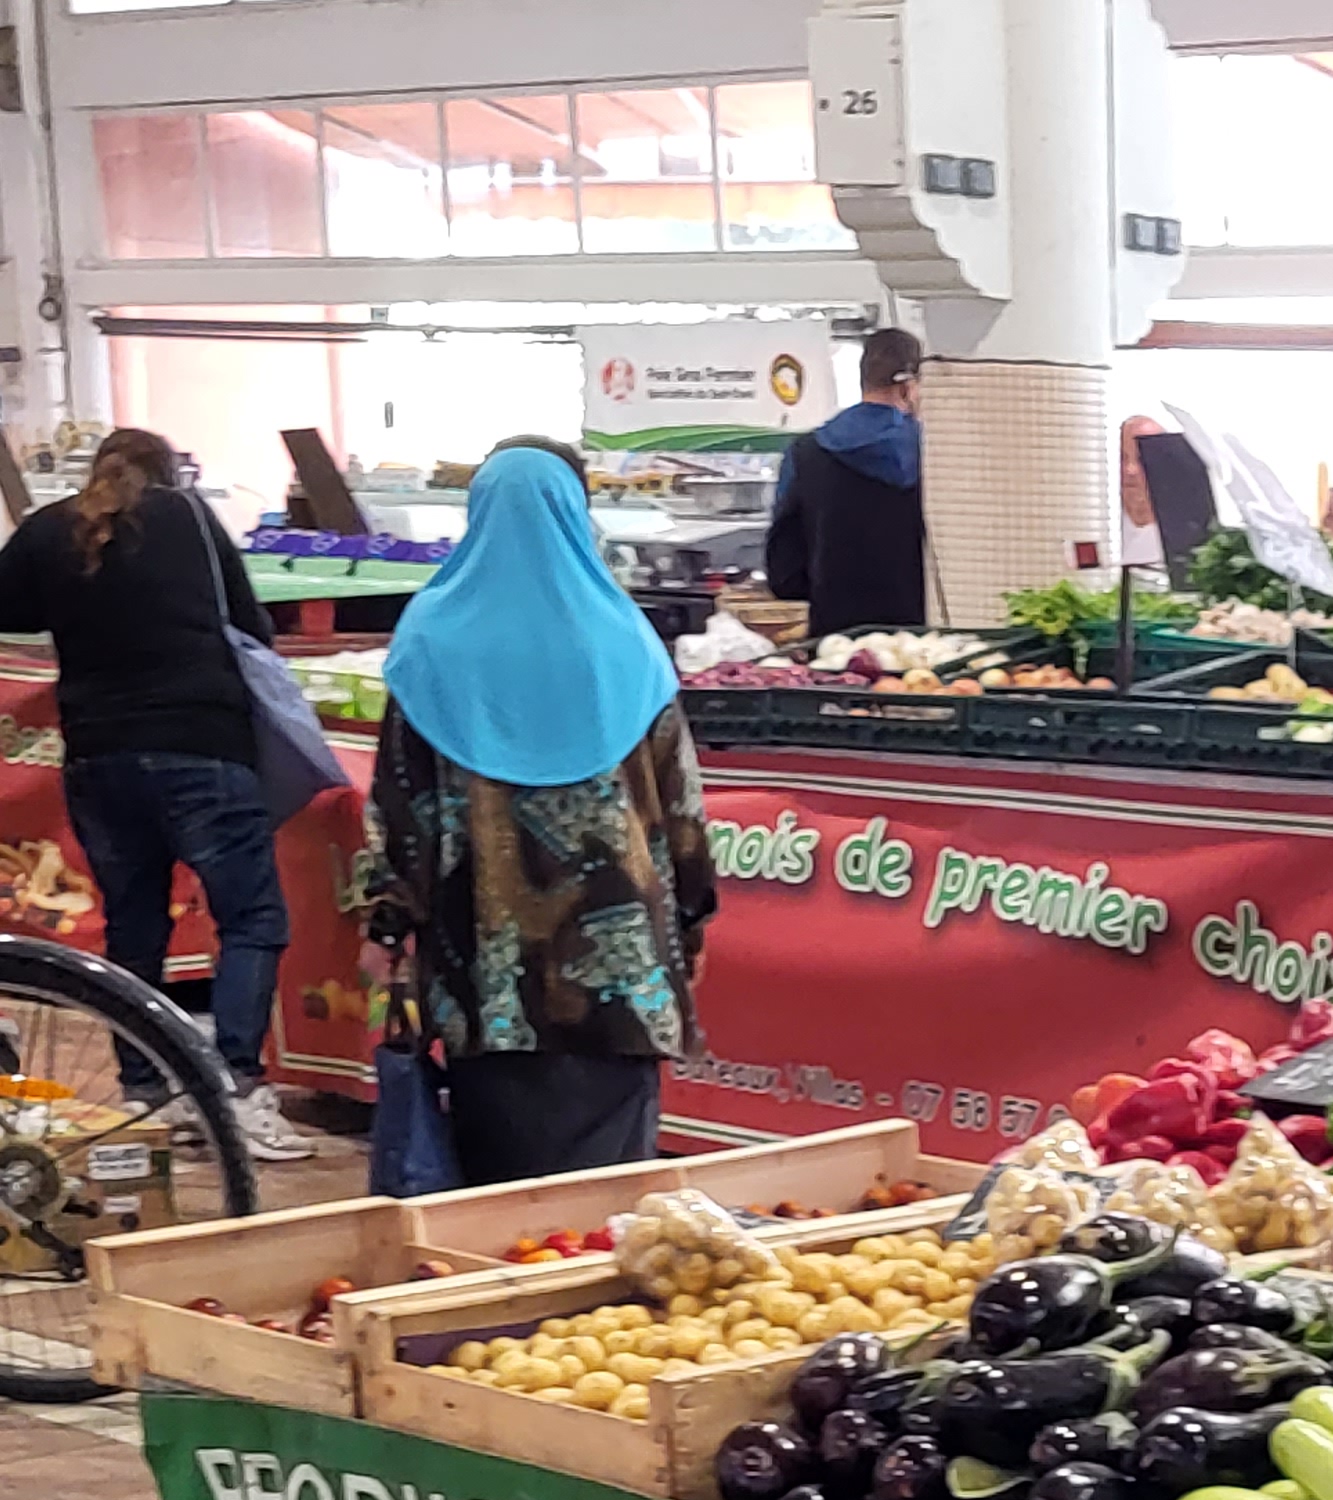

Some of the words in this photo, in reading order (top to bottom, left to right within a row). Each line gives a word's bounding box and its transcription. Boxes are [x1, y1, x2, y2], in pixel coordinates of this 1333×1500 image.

[841, 90, 878, 115] 26
[835, 814, 913, 898] de
[922, 846, 1169, 954] premier
[901, 1080, 944, 1122] 07
[950, 1086, 993, 1132] 58
[997, 1094, 1042, 1140] 57
